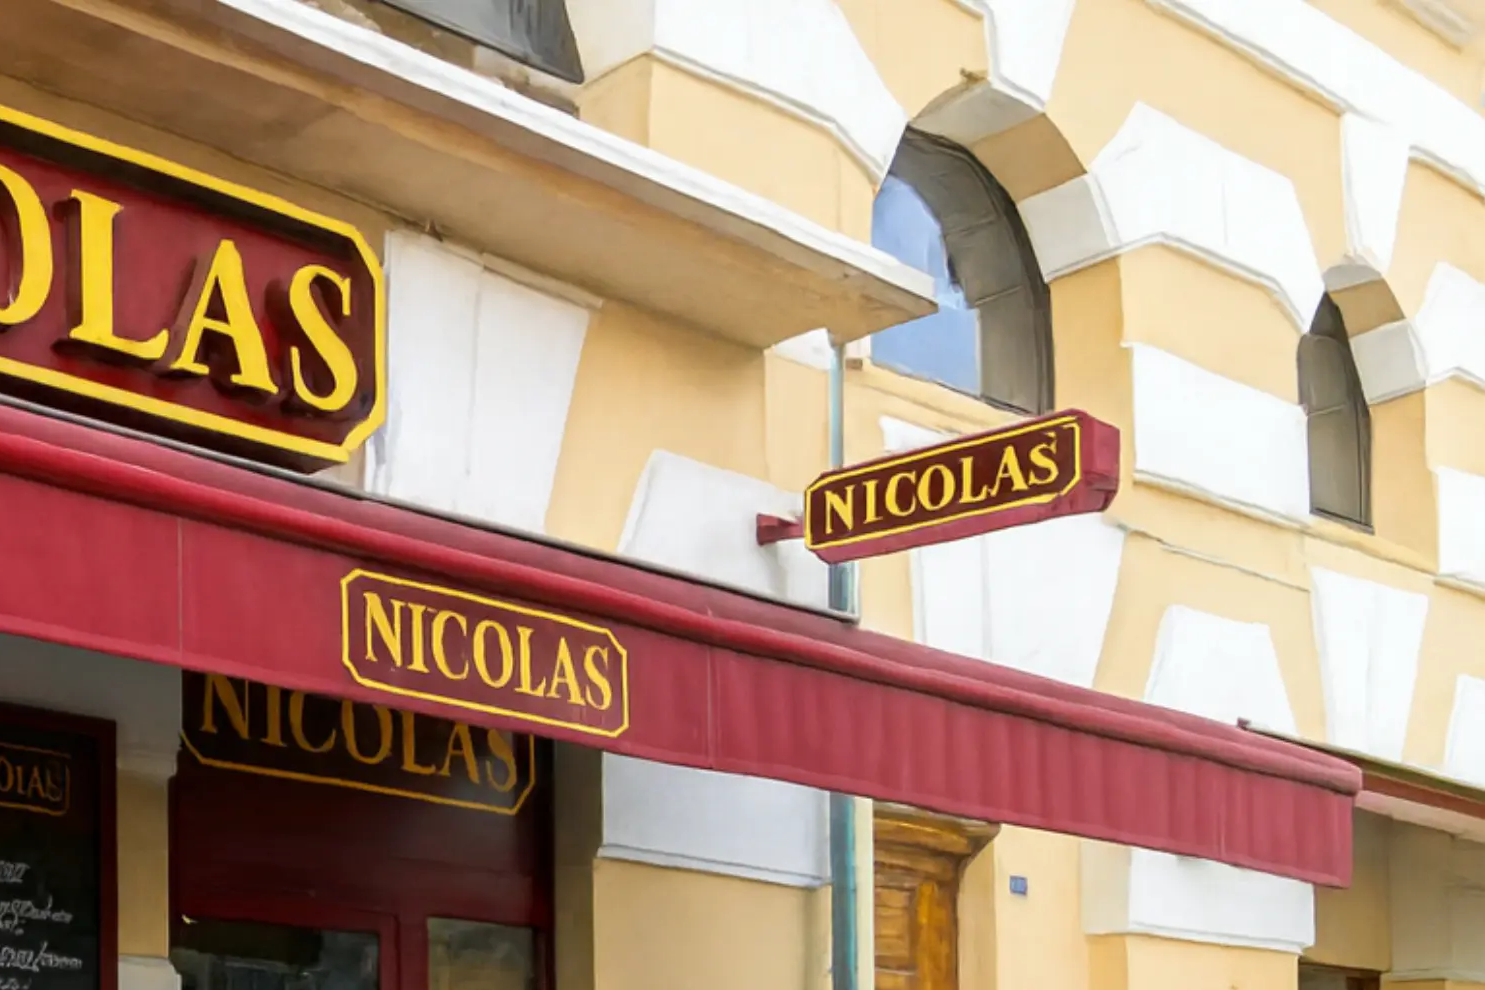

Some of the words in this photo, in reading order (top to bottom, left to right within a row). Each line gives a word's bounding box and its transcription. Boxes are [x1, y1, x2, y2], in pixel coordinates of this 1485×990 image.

[824, 431, 1059, 534] NICOLAS
[363, 592, 612, 711] NICOLAS
[201, 673, 517, 792] NICOLAS
